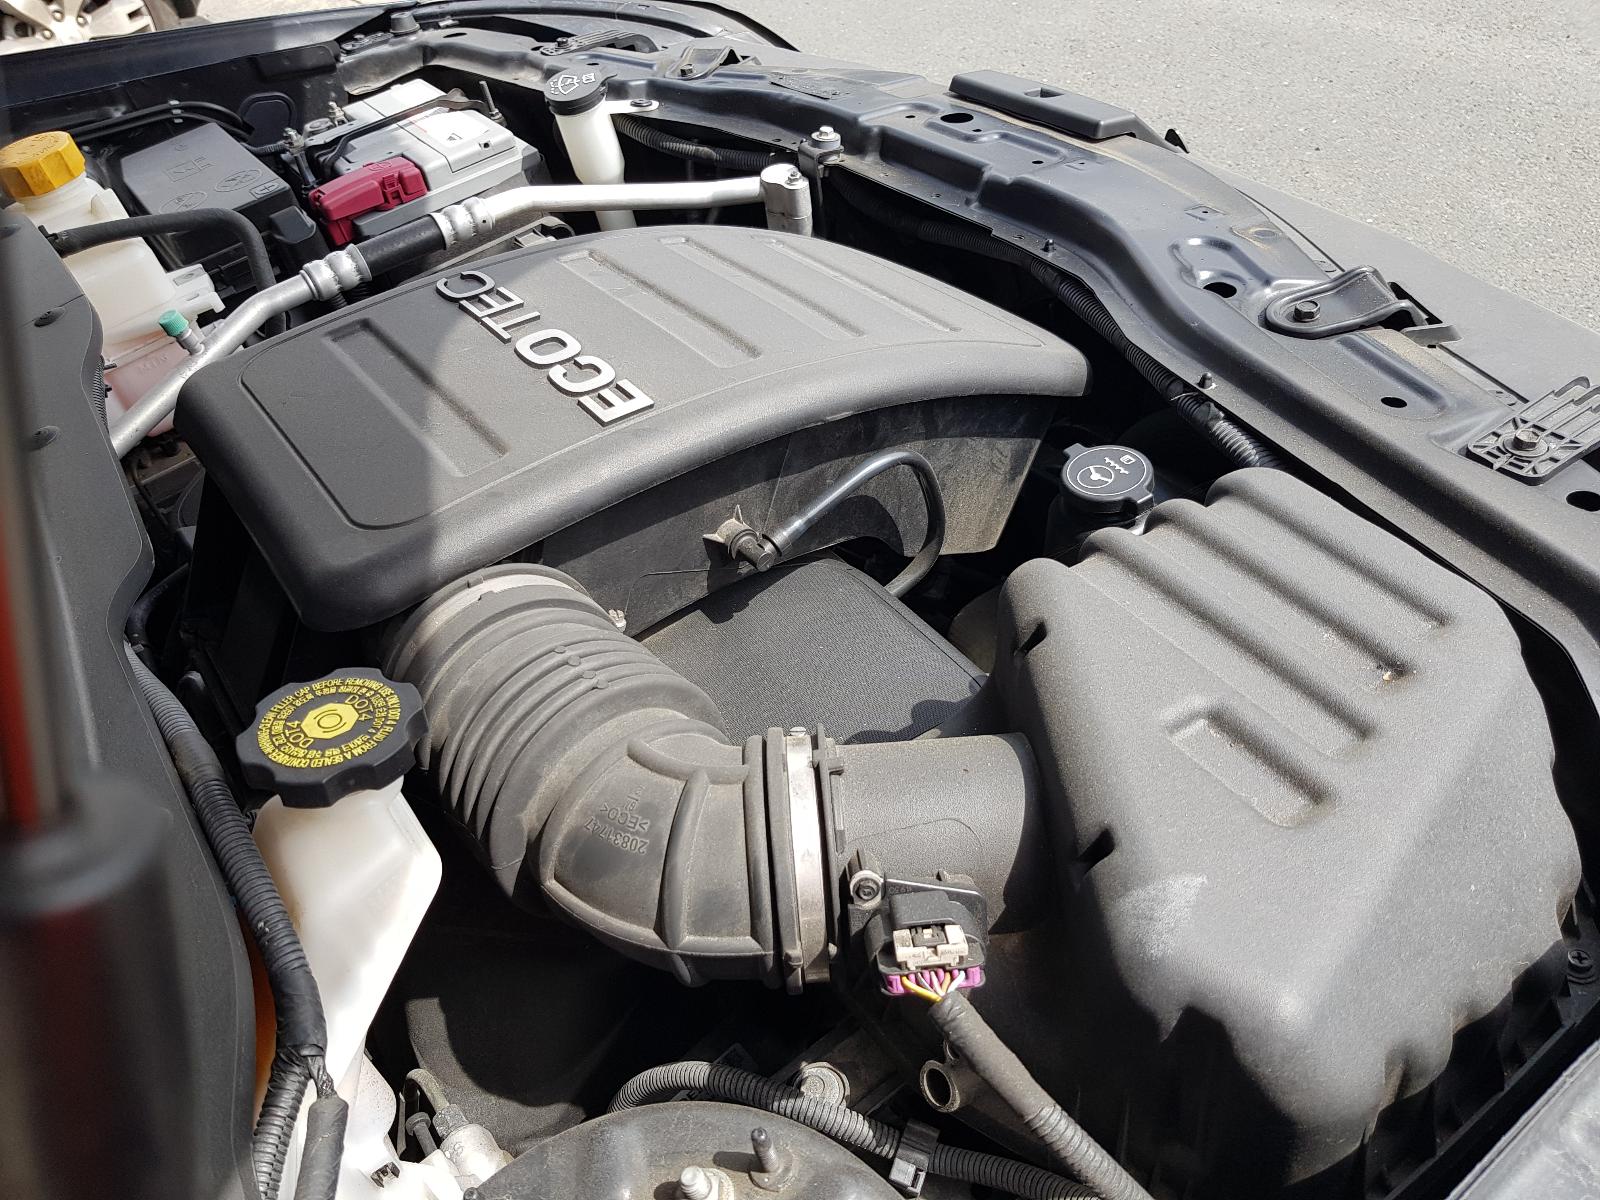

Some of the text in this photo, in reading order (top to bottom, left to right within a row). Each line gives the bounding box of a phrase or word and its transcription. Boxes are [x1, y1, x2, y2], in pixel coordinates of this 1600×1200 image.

[436, 270, 655, 428] ECOTEC
[294, 687, 311, 697] CAP
[311, 678, 344, 691] BEFORE
[344, 677, 383, 691] REMOVING
[272, 695, 297, 714] FILLER
[354, 740, 378, 757] FROM
[268, 750, 310, 769] CONTAINER
[309, 754, 344, 769] SEALED
